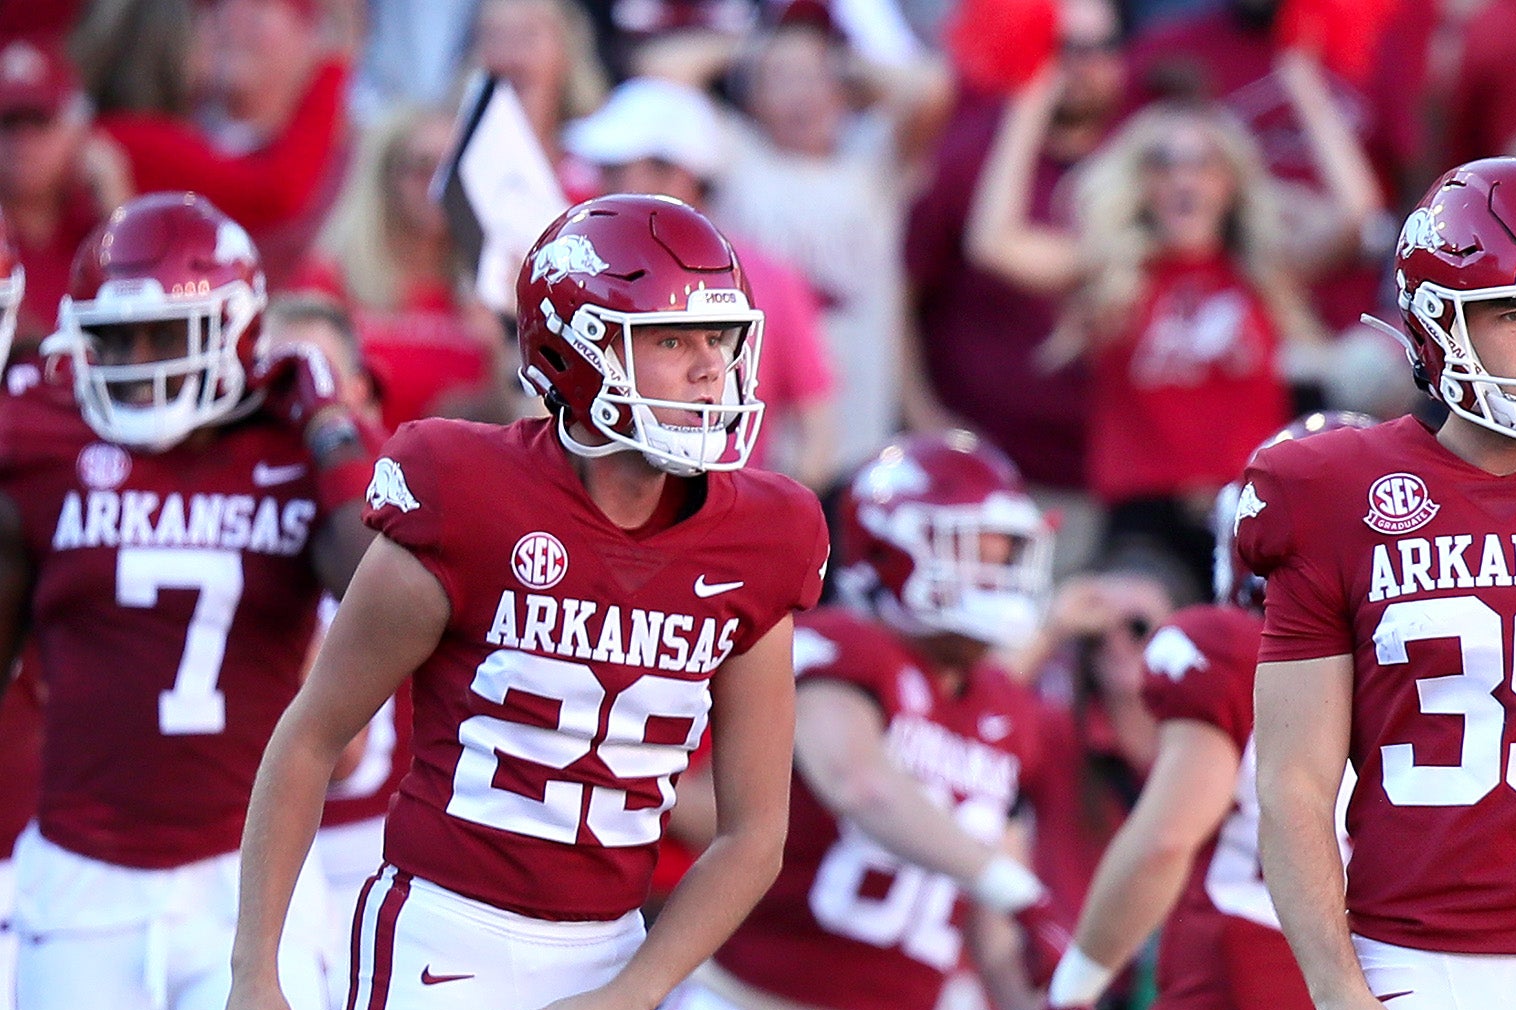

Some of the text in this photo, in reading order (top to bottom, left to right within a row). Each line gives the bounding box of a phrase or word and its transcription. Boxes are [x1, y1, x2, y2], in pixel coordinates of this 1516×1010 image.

[52, 489, 316, 556] ARKANSAS
[1374, 478, 1420, 516] SEC
[1377, 511, 1427, 531] GRADUATE
[517, 537, 563, 584] SEC
[115, 549, 245, 735] 7
[486, 590, 740, 673] ARKANSAS
[446, 650, 712, 848] 29
